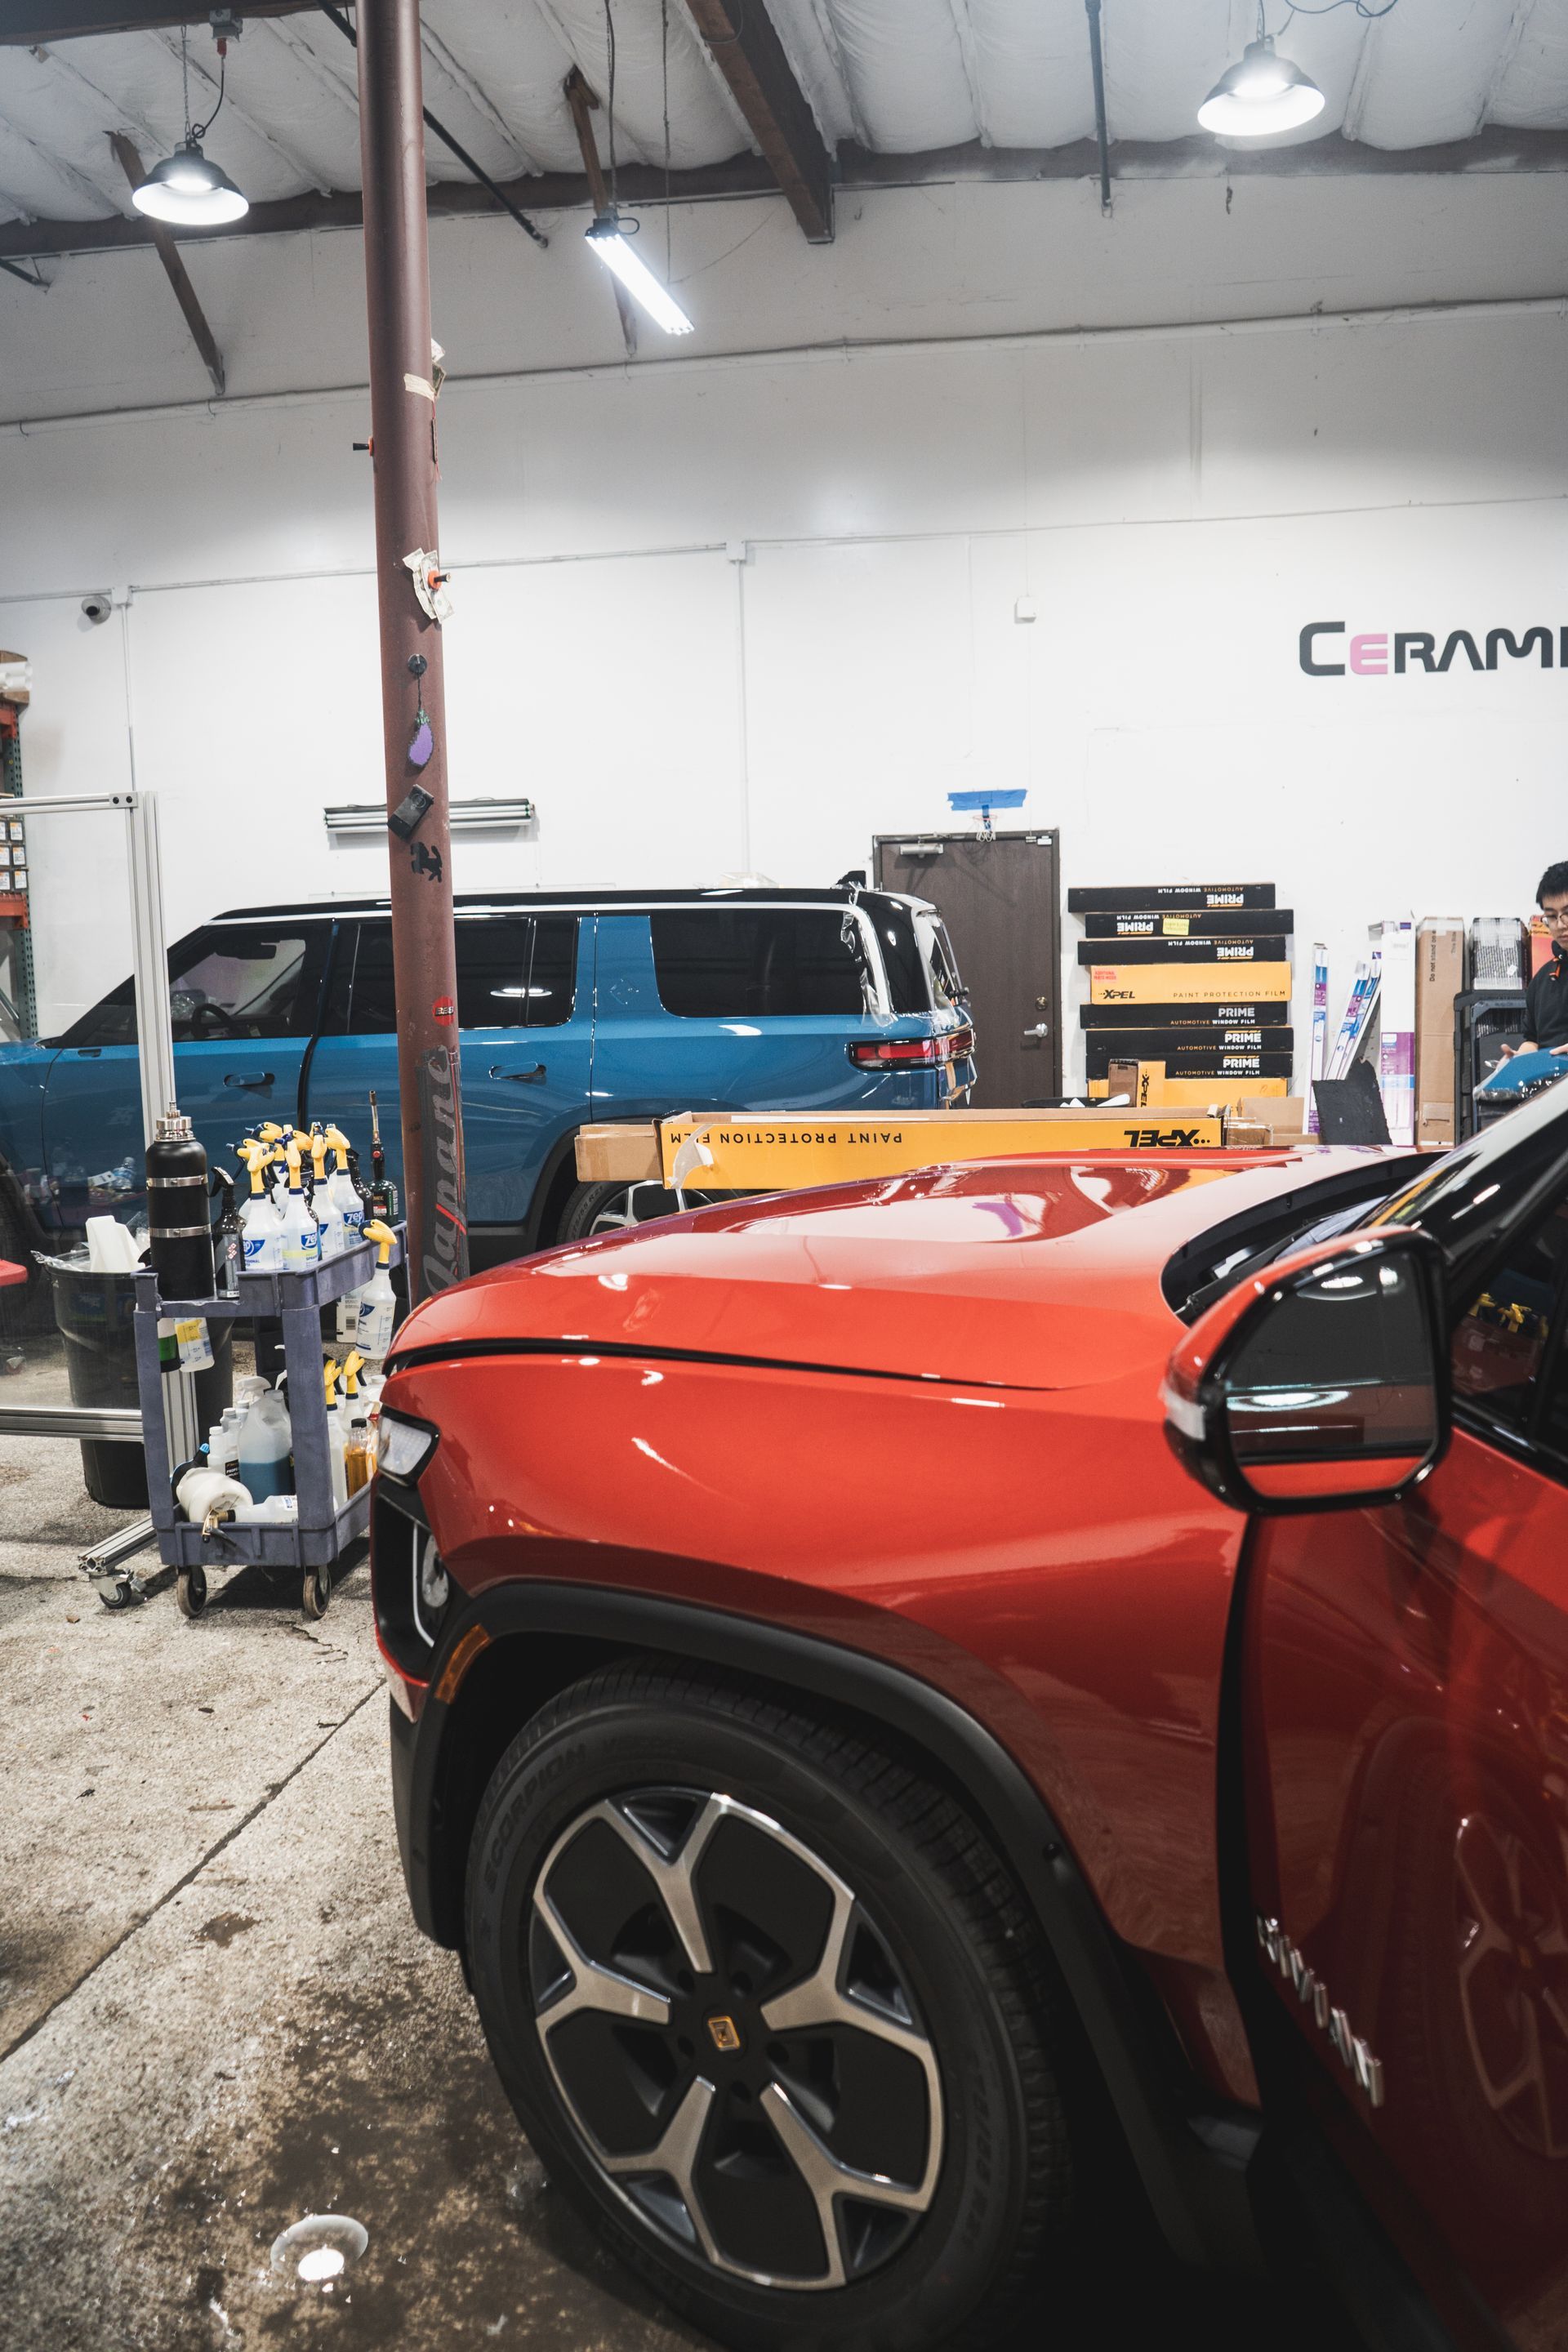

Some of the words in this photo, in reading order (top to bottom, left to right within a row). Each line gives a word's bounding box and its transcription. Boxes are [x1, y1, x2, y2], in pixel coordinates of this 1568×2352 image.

[1206, 893, 1244, 905] PRIME
[1116, 921, 1154, 933] PRIME
[1216, 947, 1254, 957] PRIME
[1429, 973, 1436, 982] Do
[1103, 989, 1135, 999] XPEL
[1218, 1007, 1255, 1018] PRIME
[1225, 1033, 1262, 1043] PRIME
[1223, 1058, 1260, 1068] PRIME
[1140, 1074, 1150, 1107] XPEL
[720, 1133, 837, 1143] PROTECTION
[848, 1133, 902, 1143] PAINT
[1124, 1129, 1200, 1147] XPEL
[483, 1743, 586, 1895] SCORPION
